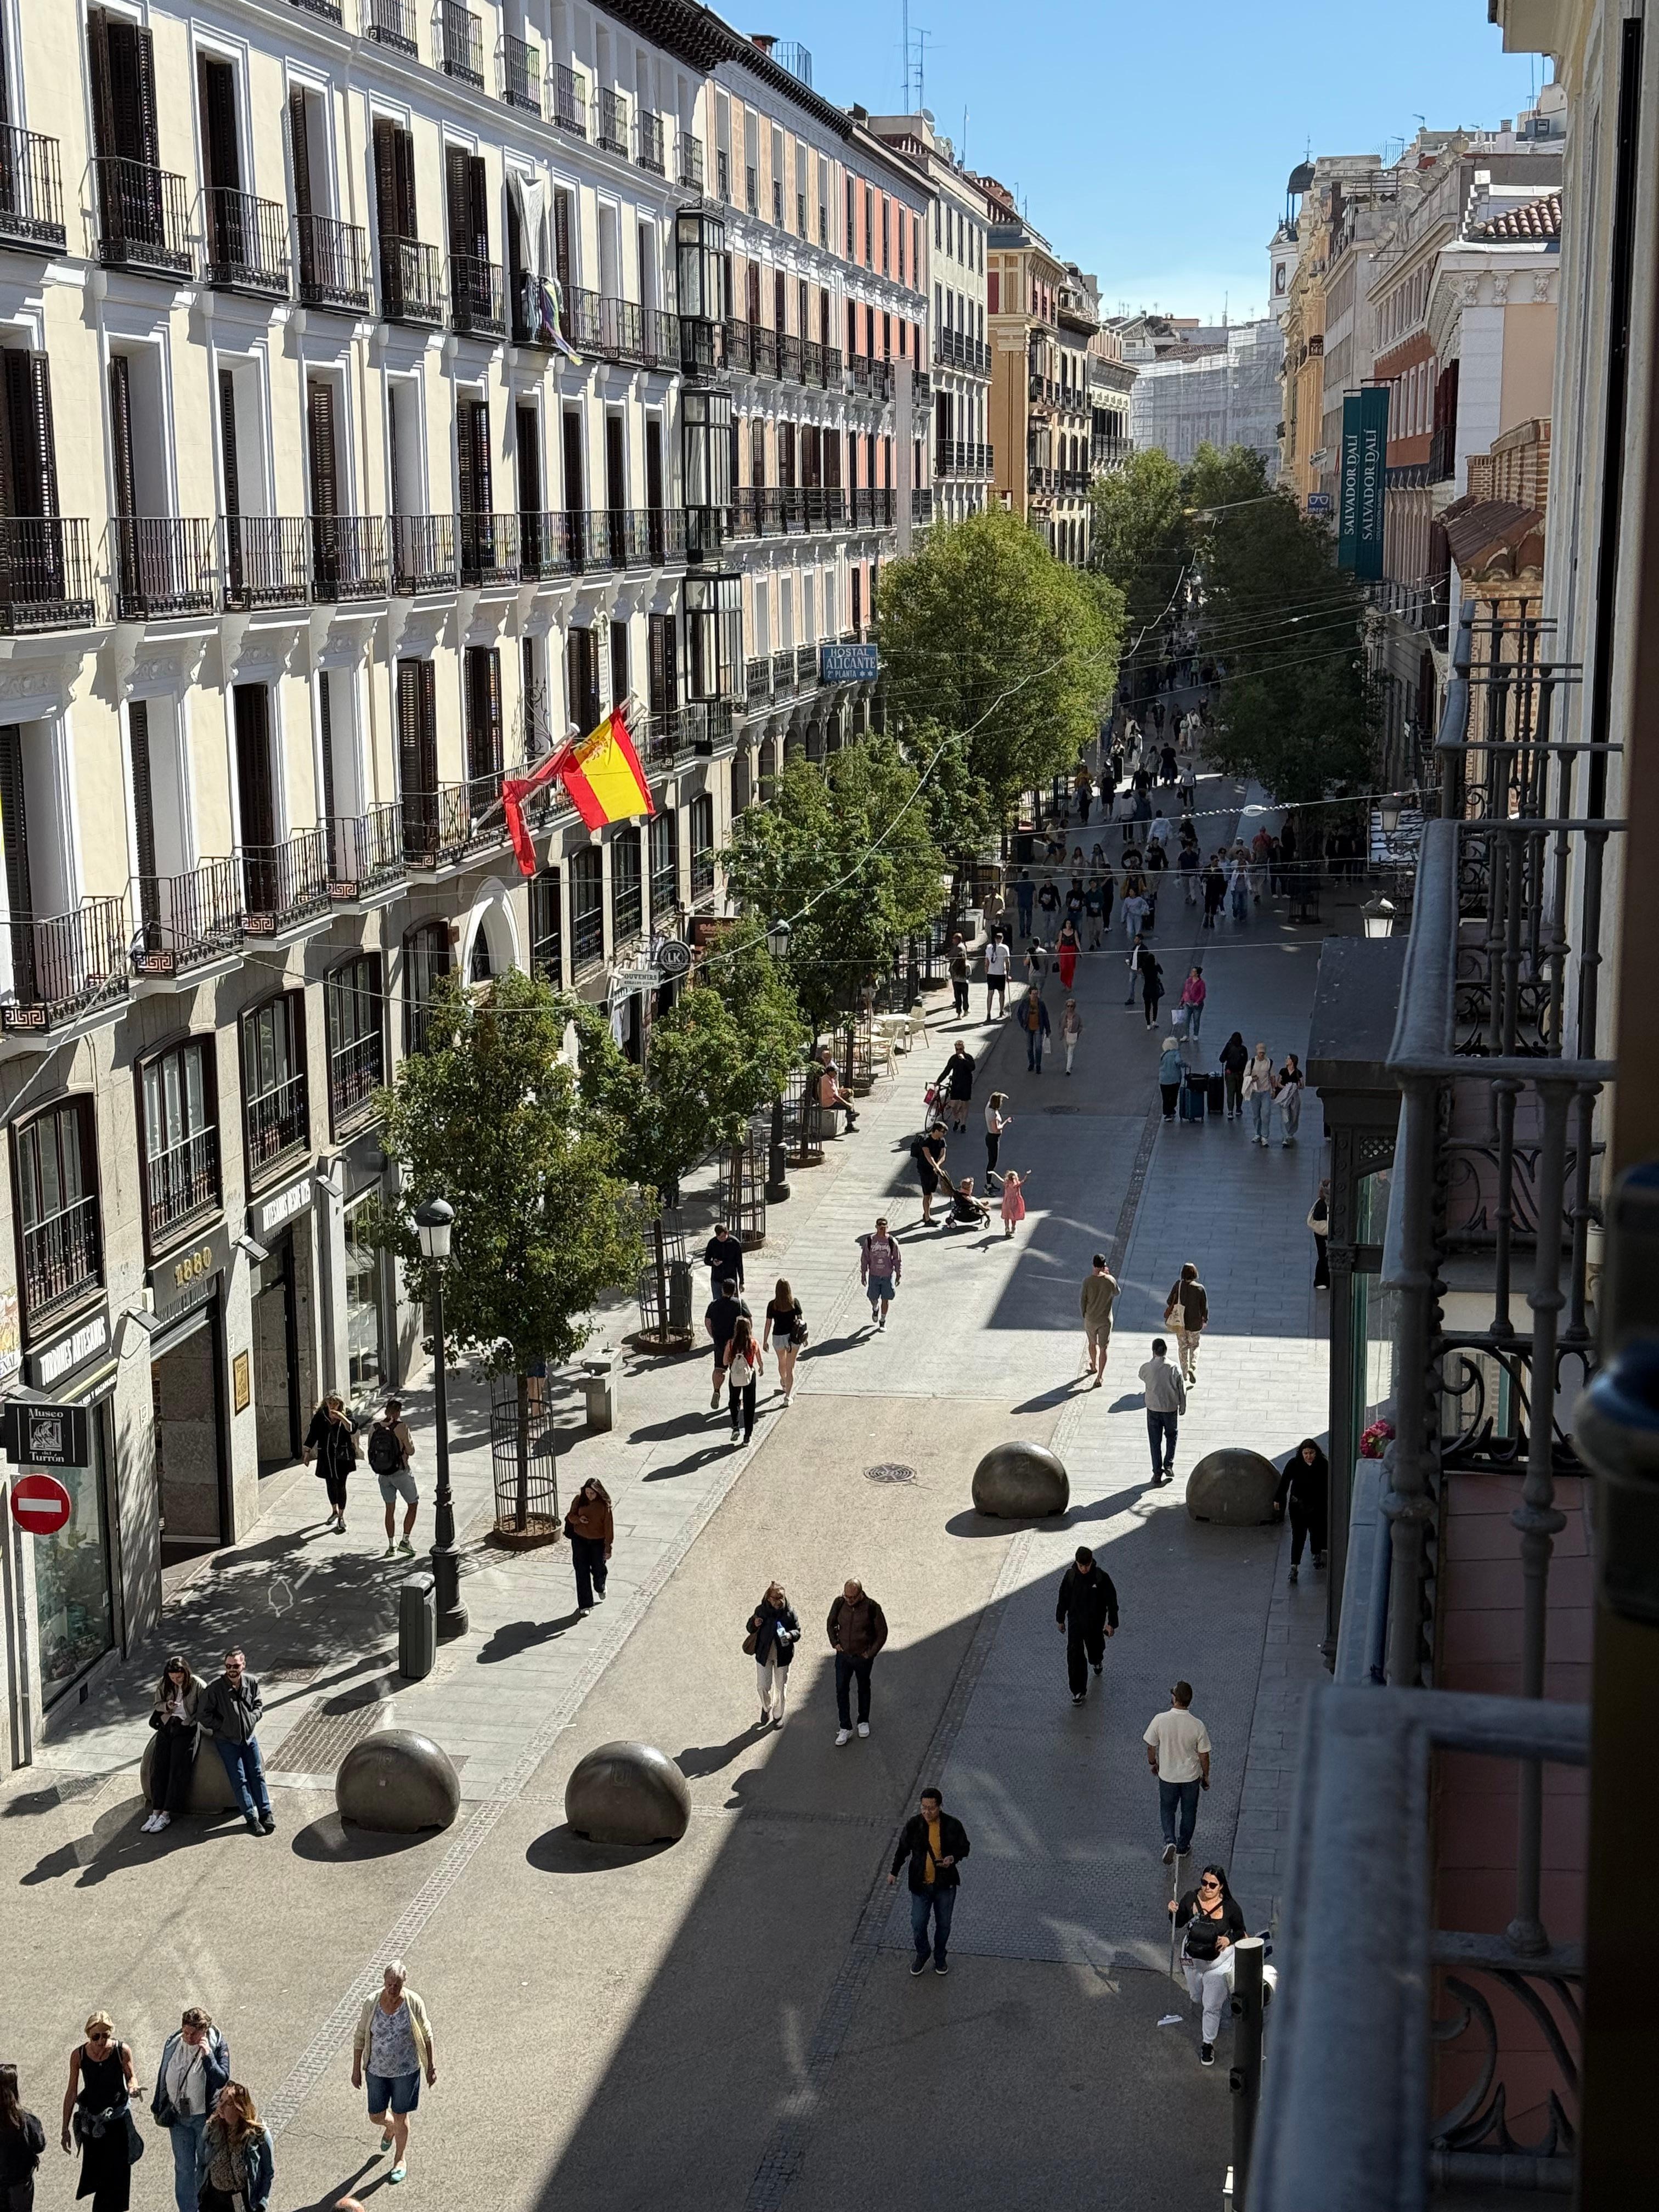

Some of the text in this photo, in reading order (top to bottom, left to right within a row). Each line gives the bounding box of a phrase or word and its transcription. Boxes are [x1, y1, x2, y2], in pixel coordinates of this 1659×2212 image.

[1344, 435, 1360, 535] SALVADOR DALÍ
[1362, 429, 1380, 540] SALVADOR DALÍ
[831, 648, 870, 657] HOSTAL
[826, 657, 876, 669] ALICANTE
[835, 670, 857, 678] PLANTA
[668, 952, 681, 963] LK
[262, 1193, 288, 1232] ARTESANOS
[286, 1184, 302, 1215] DESDE
[174, 1246, 212, 1288] 1880
[39, 1316, 106, 1386] TURRONES ARTESANOS
[28, 1408, 64, 1419] Museo
[29, 1451, 65, 1463] Turrón
